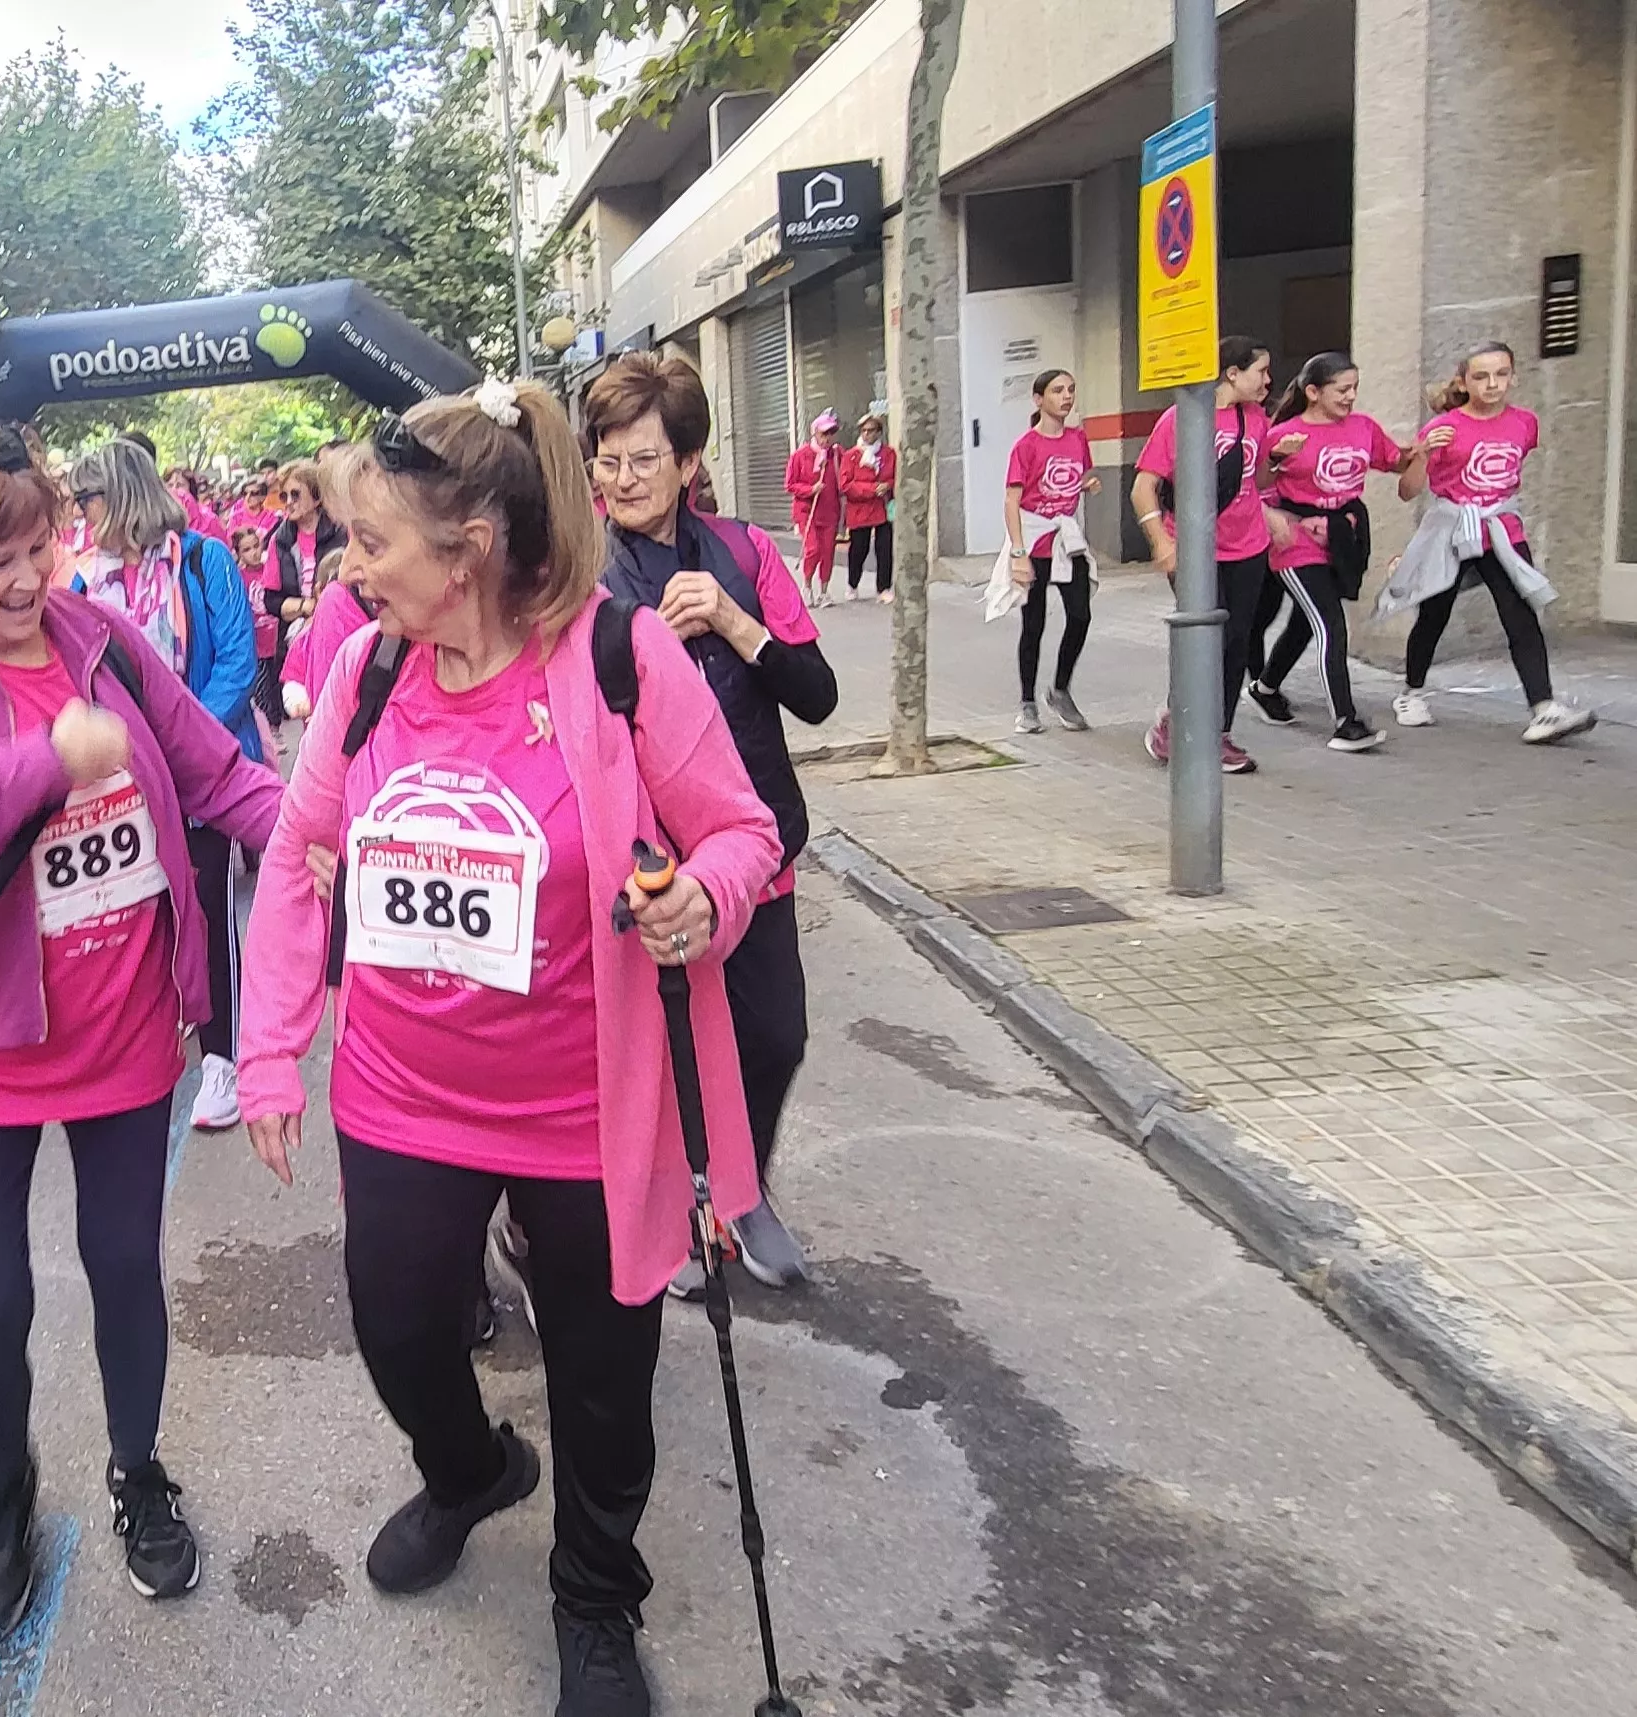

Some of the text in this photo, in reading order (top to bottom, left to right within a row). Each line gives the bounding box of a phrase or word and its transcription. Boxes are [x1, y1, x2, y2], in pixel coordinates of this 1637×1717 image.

[410, 376, 442, 401] mejo
[44, 823, 141, 888] 889
[366, 849, 428, 871] CONTRA
[431, 854, 447, 872] EL
[384, 877, 492, 938] 886
